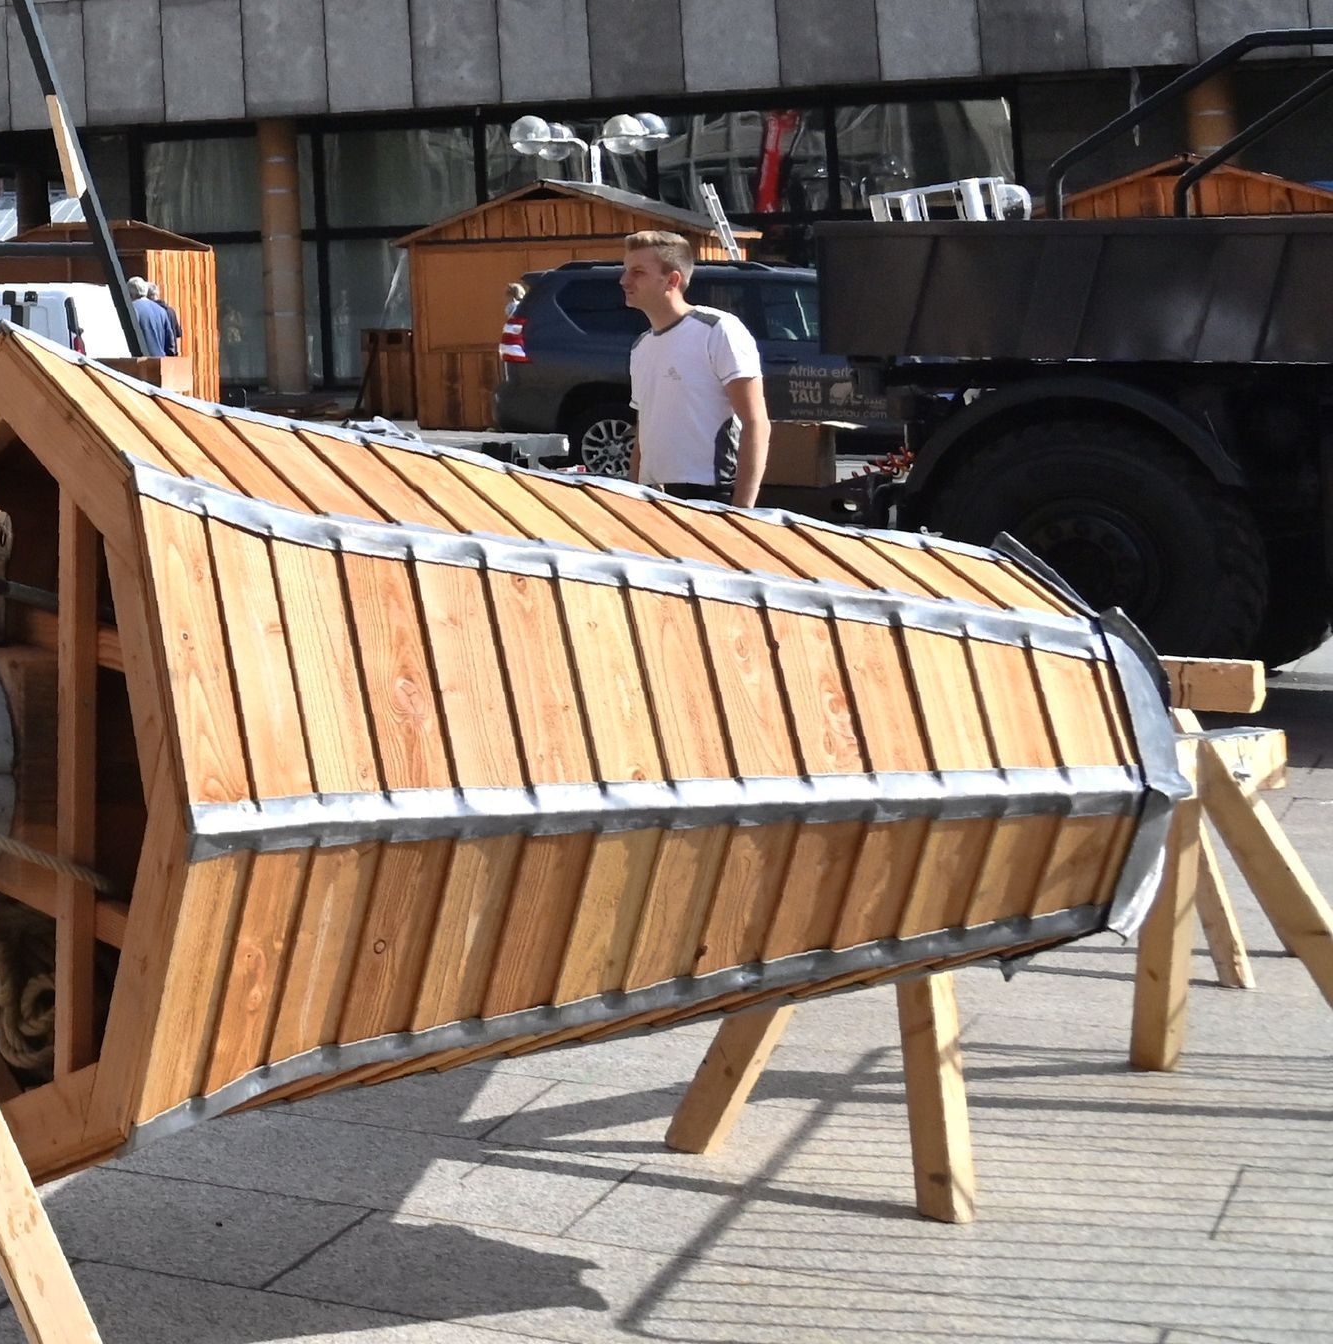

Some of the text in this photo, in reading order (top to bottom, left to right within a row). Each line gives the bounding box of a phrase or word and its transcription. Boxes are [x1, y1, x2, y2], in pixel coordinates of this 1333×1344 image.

[789, 365, 827, 378] Afrika
[789, 380, 821, 389] THULA
[789, 389, 823, 404] TAU
